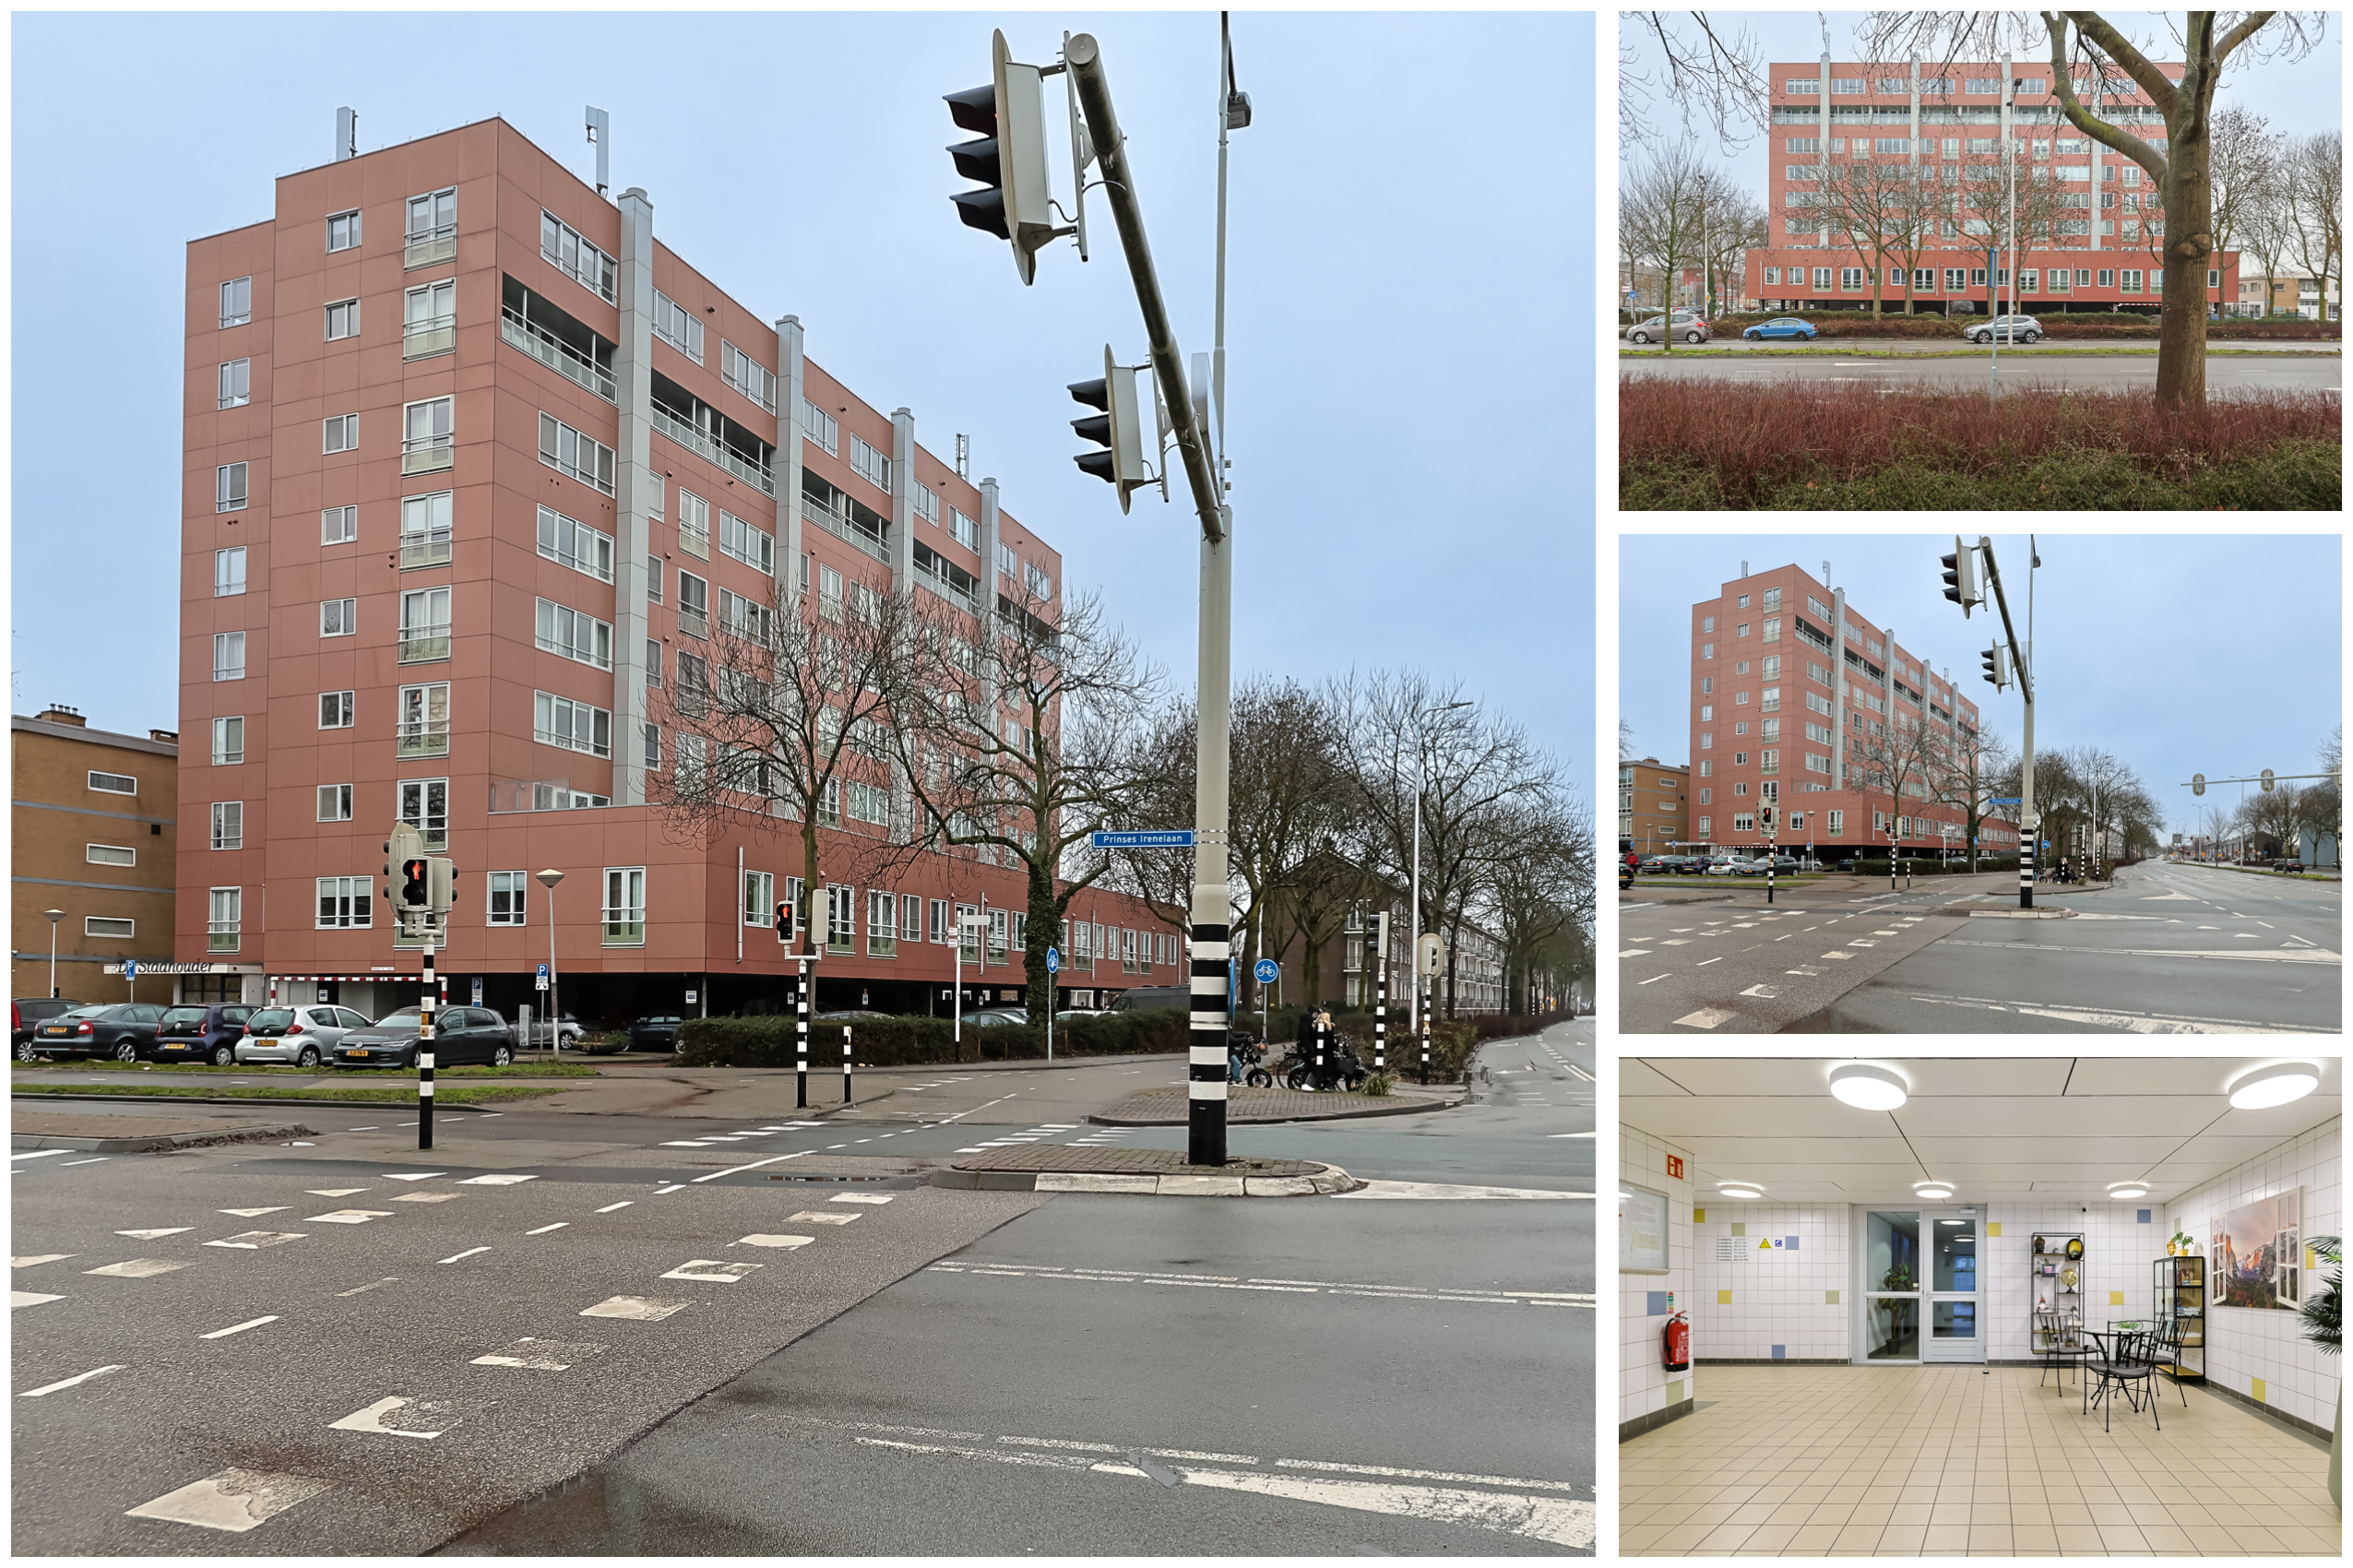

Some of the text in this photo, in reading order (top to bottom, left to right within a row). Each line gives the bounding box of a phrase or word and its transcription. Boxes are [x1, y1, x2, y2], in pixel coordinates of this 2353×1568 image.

[1103, 834, 1182, 844] Prinses Irenelaan
[137, 957, 214, 973] Stadhouder
[539, 965, 546, 975] P
[474, 980, 480, 989] P
